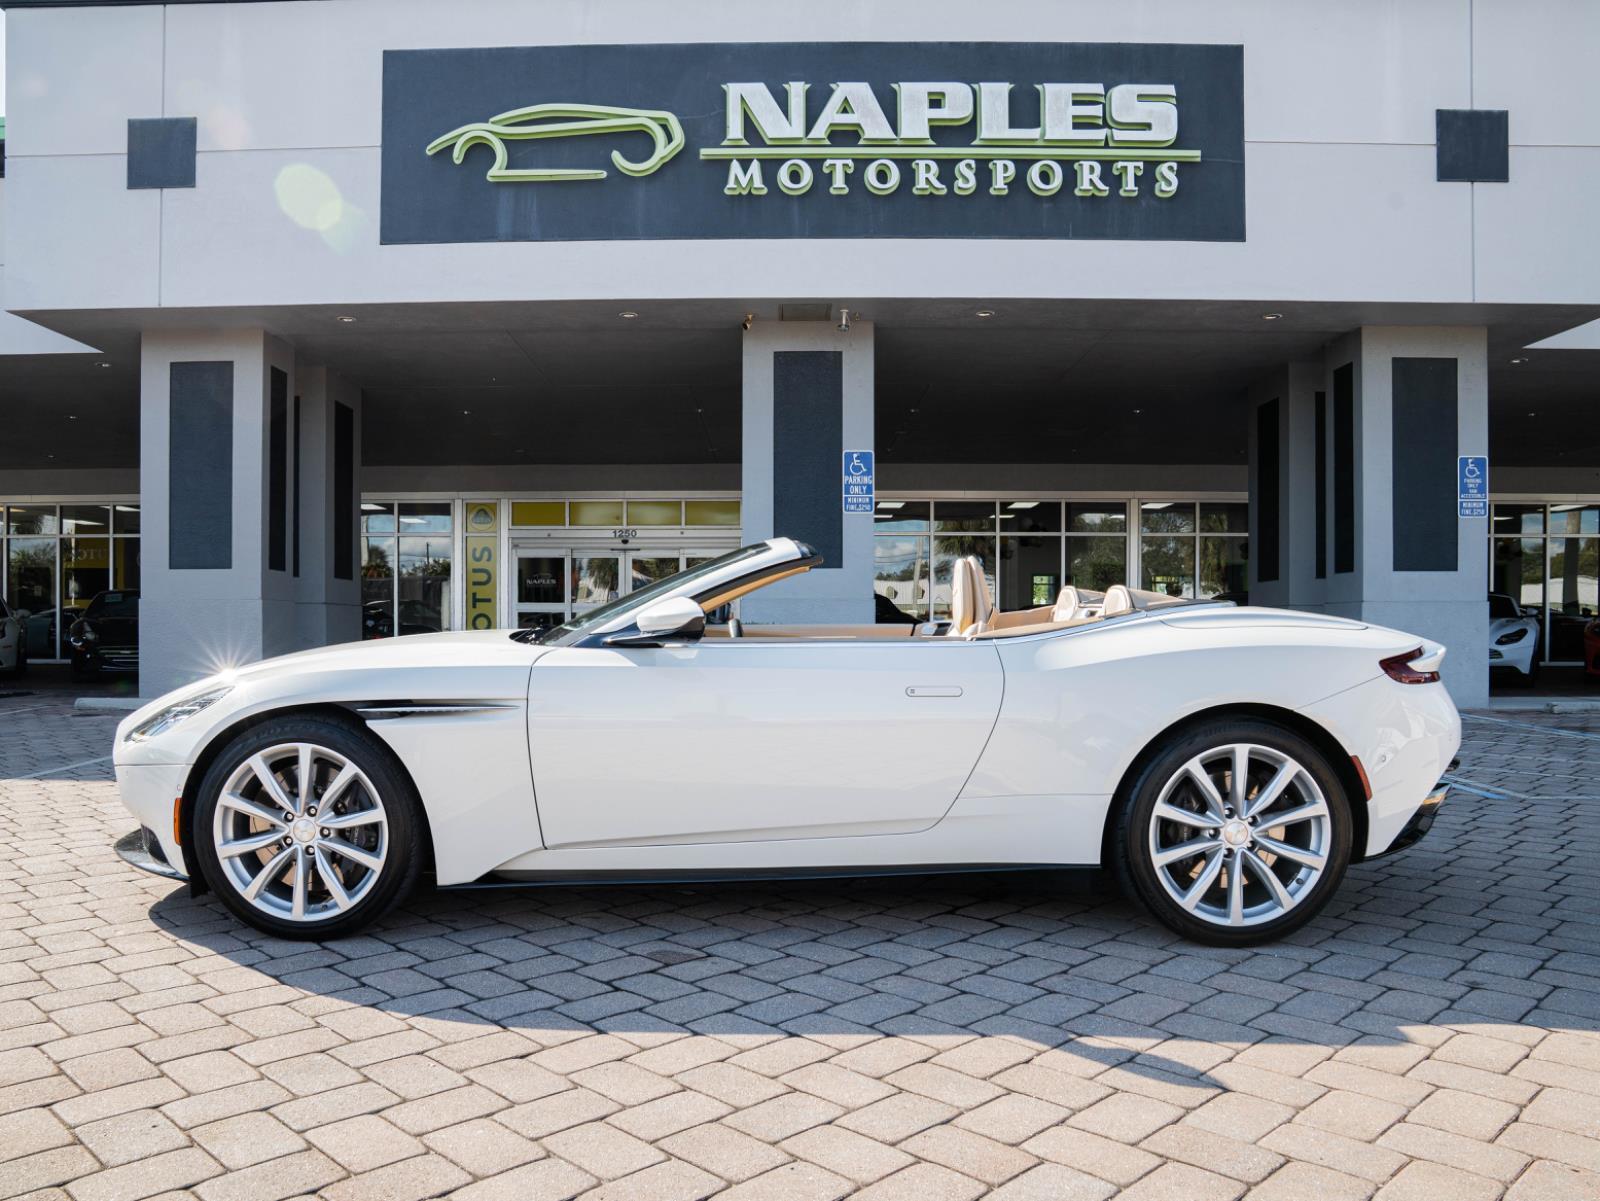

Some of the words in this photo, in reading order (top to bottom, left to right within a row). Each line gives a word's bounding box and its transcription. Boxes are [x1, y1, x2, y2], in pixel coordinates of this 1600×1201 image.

[721, 81, 1178, 147] NAPLES
[725, 159, 1180, 198] MOTORSPORTS
[846, 475, 872, 484] PARKING
[850, 485, 867, 494] ONLY
[612, 529, 637, 538] 1250
